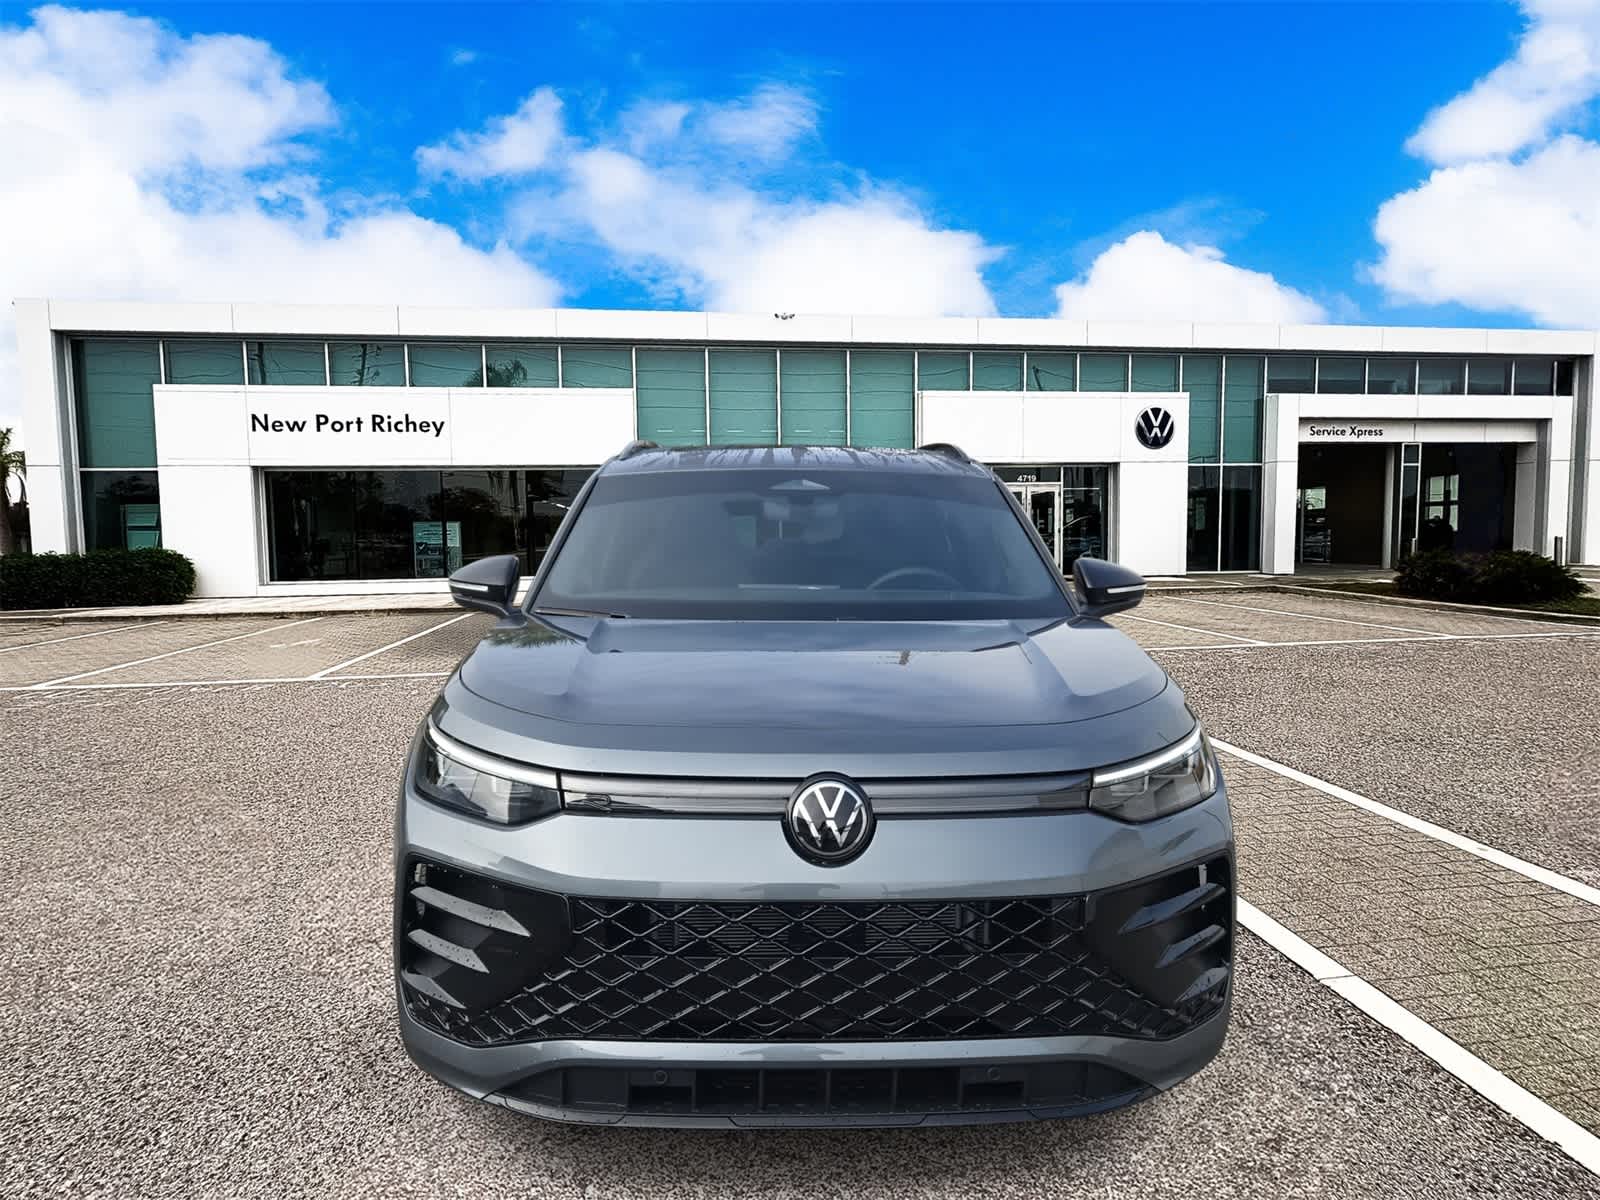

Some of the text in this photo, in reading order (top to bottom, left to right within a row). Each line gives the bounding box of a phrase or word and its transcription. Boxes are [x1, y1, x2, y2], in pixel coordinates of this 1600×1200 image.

[251, 413, 445, 437] New Port Richey
[1309, 425, 1383, 438] Service Xpress
[1017, 474, 1036, 482] 4719
